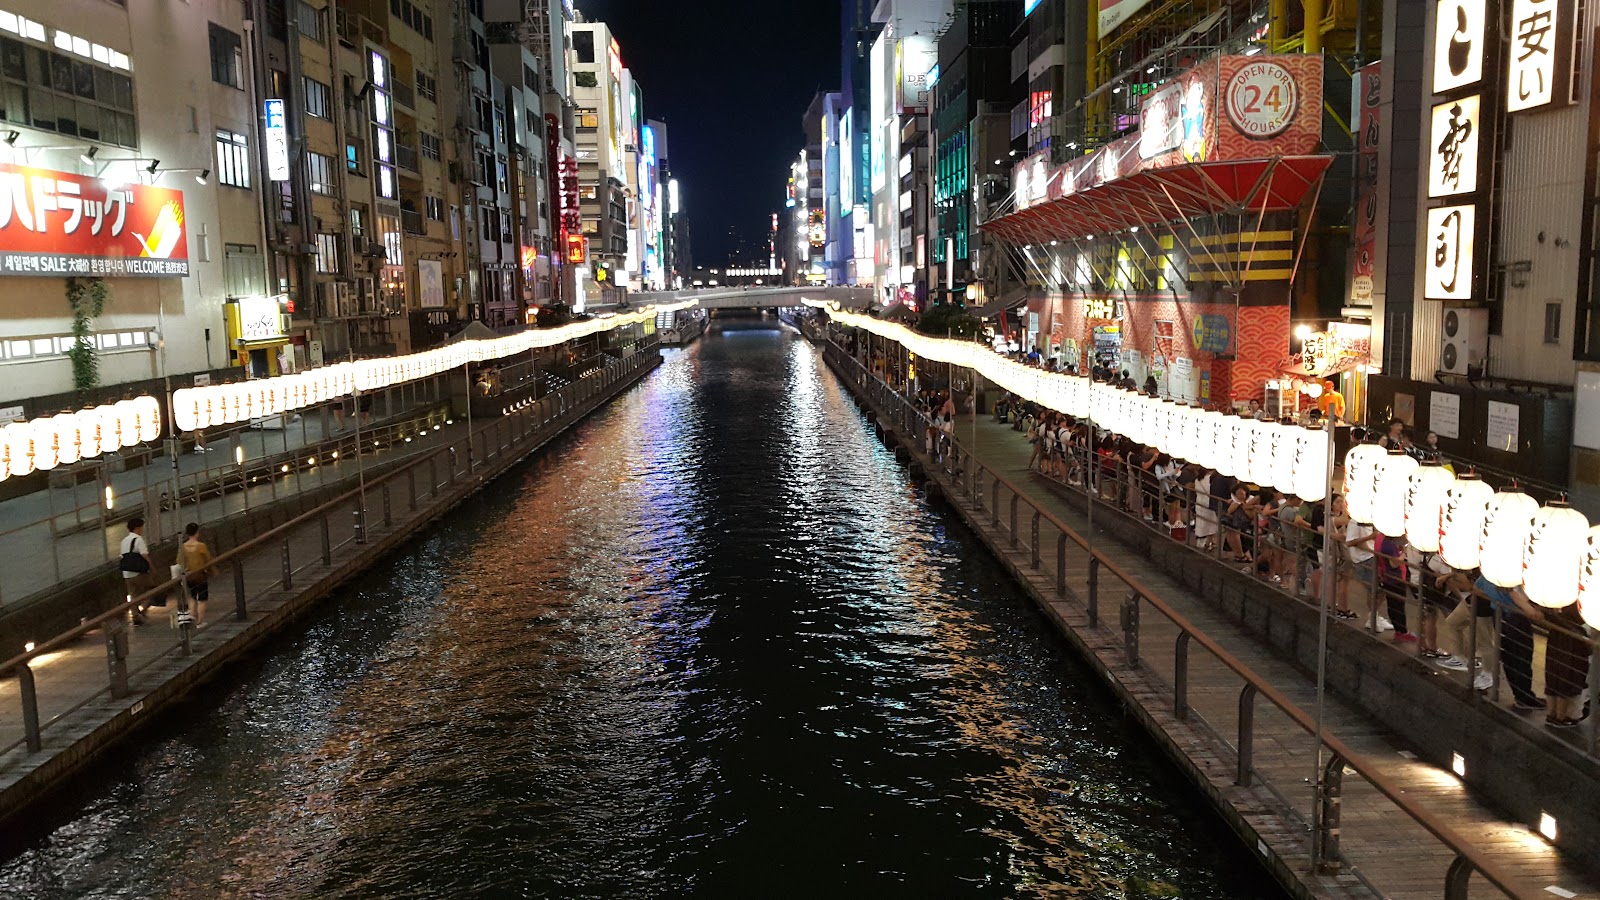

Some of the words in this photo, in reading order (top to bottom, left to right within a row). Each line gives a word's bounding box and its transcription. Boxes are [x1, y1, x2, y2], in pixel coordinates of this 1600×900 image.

[1517, 0, 1552, 102] 安い
[1238, 65, 1265, 85] OPEN
[1267, 67, 1289, 85] FOR
[1244, 85, 1281, 113] 24
[1241, 117, 1283, 132] HOURS
[5, 254, 40, 271] 세일판매
[40, 256, 67, 272] SALE
[125, 260, 166, 274] WELCOME
